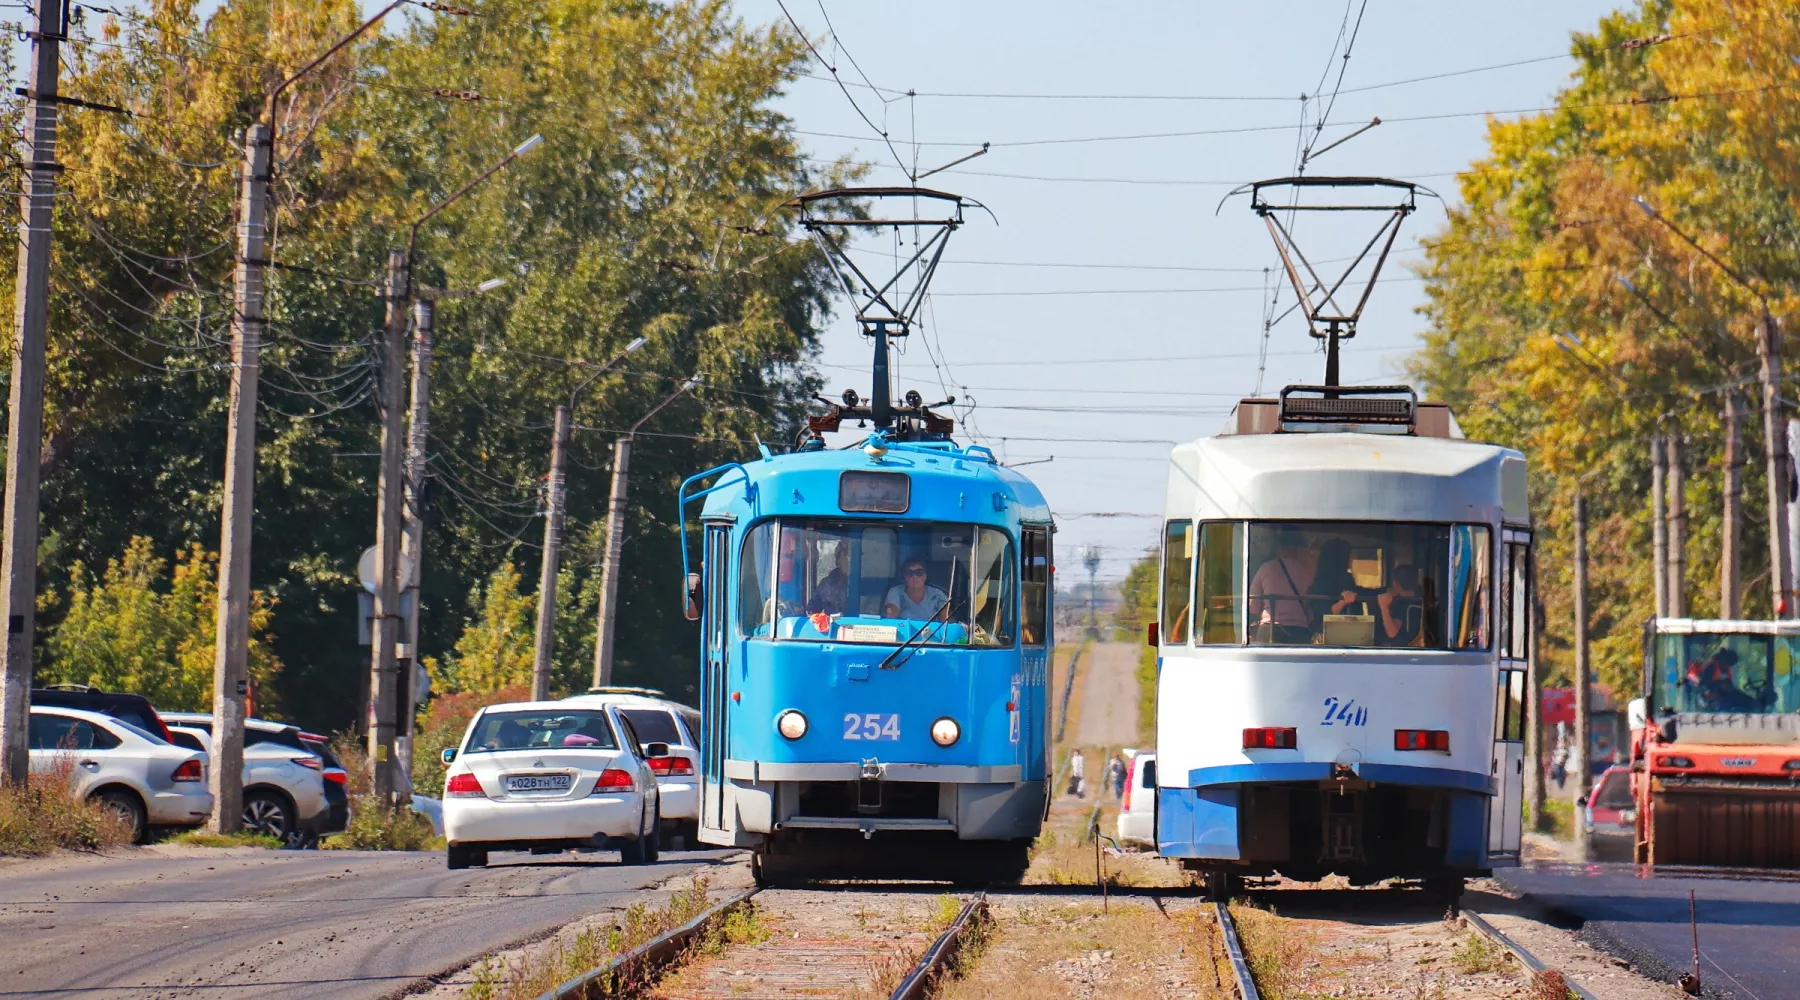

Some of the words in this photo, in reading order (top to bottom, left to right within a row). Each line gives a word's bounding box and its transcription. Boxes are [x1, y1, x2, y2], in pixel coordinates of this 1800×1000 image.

[1320, 697, 1368, 726] 240
[843, 713, 901, 741] 254
[552, 776, 567, 785] 122
